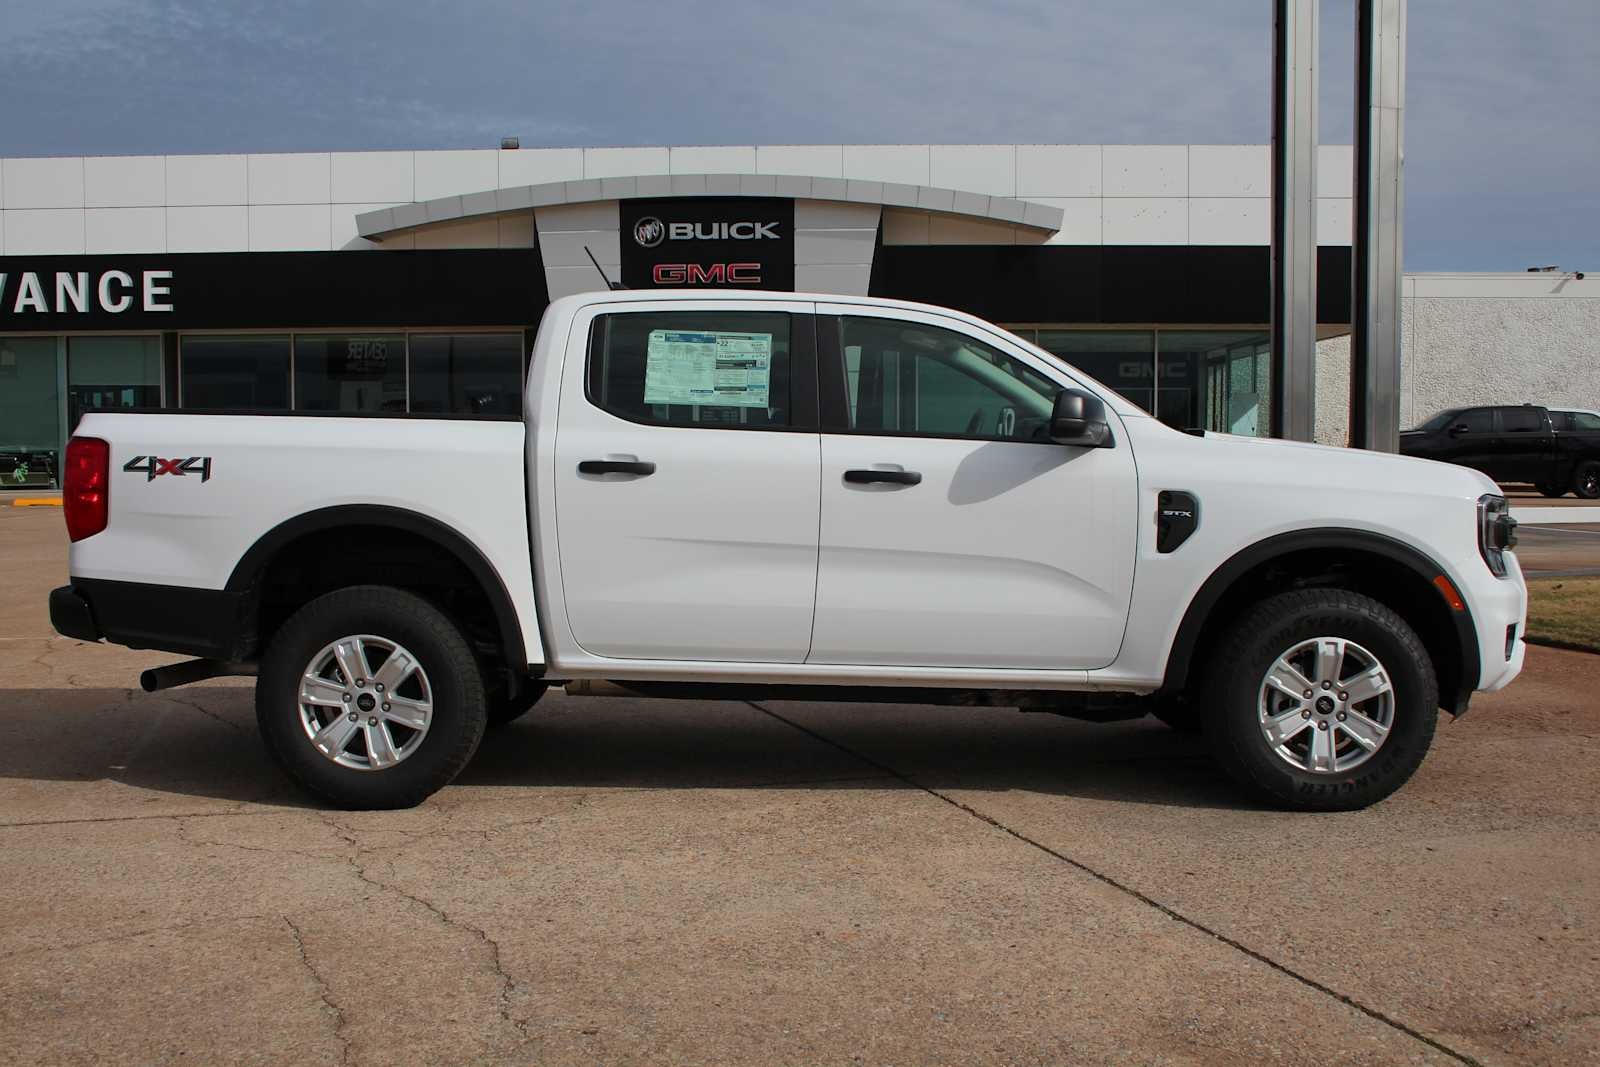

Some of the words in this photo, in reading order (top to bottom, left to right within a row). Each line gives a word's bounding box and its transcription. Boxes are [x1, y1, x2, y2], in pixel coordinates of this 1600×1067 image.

[669, 221, 781, 241] BUICK
[653, 263, 761, 284] GMC
[0, 270, 174, 313] ANCE
[1119, 361, 1188, 378] GMC
[1163, 510, 1193, 518] STX
